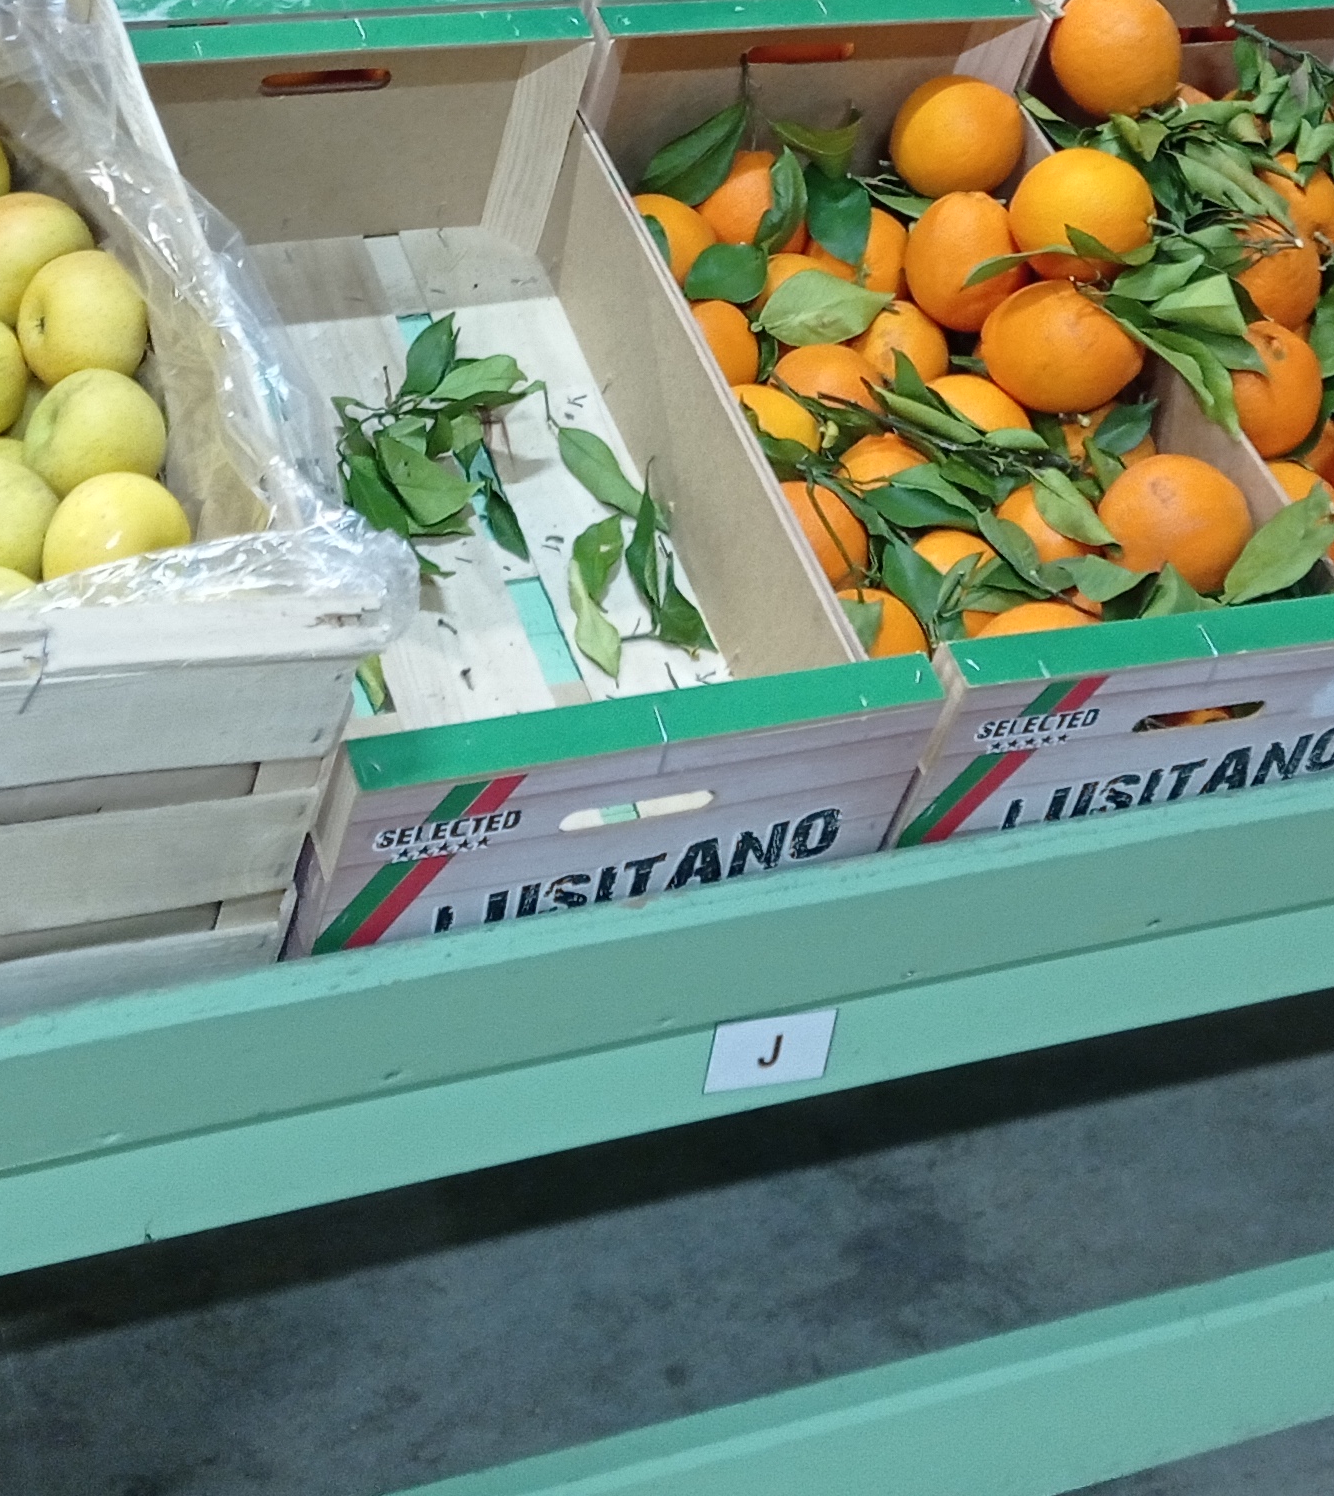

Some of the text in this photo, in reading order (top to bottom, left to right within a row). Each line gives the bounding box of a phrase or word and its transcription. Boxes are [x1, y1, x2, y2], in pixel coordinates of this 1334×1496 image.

[977, 708, 1101, 739] SELECTED
[374, 809, 522, 850] SELECTED
[757, 1034, 784, 1068] J
